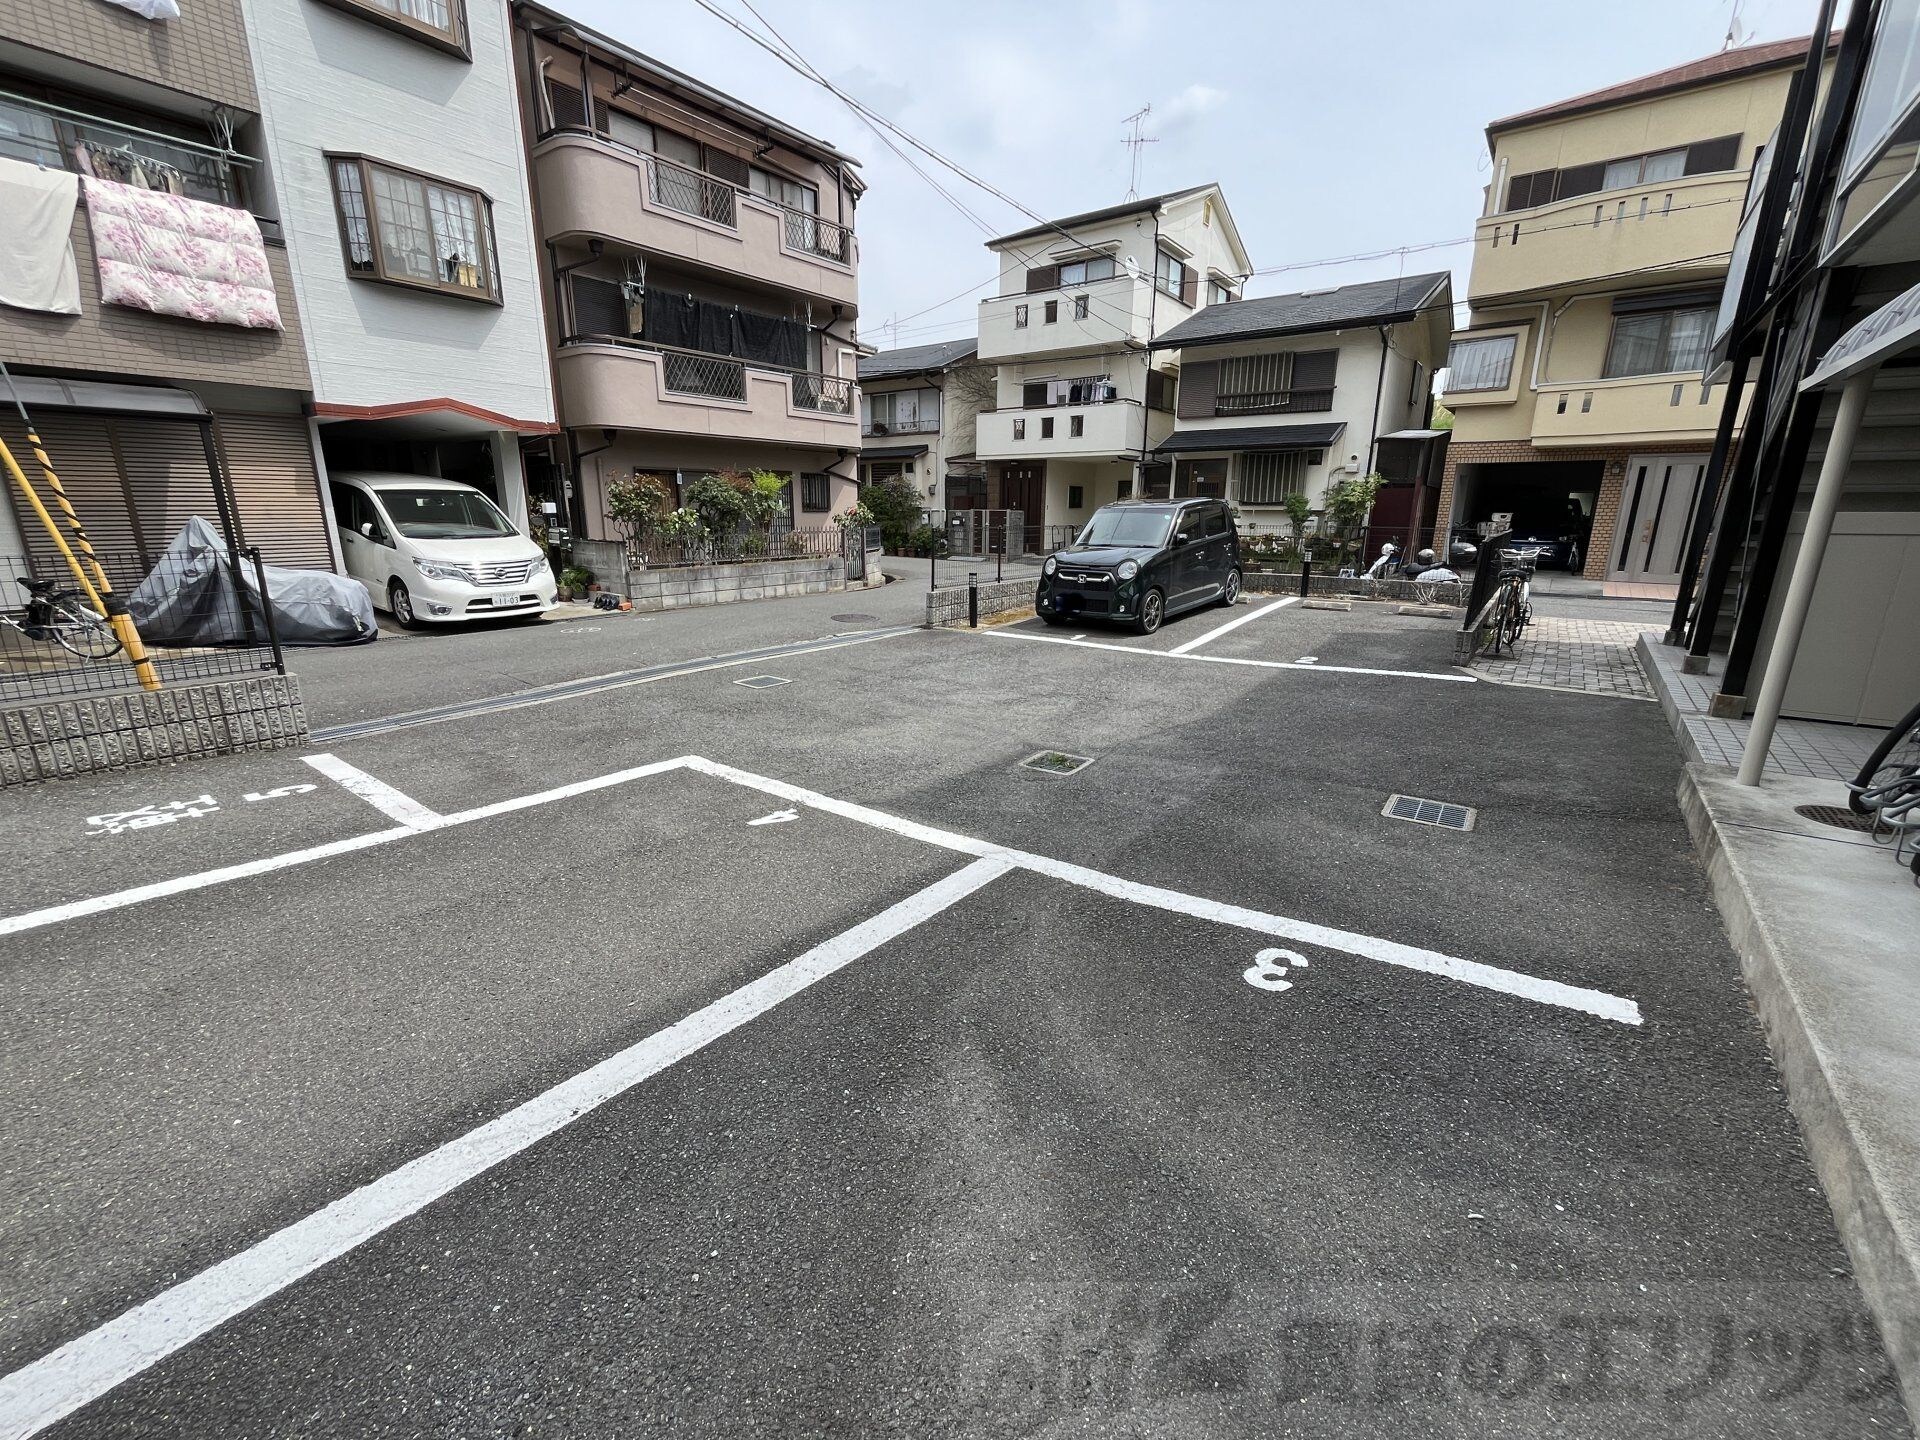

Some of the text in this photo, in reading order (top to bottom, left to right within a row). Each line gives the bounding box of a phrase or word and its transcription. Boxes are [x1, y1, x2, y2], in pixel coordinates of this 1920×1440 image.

[84, 783, 319, 836] 軽 5
[1241, 947, 1309, 992] 3
